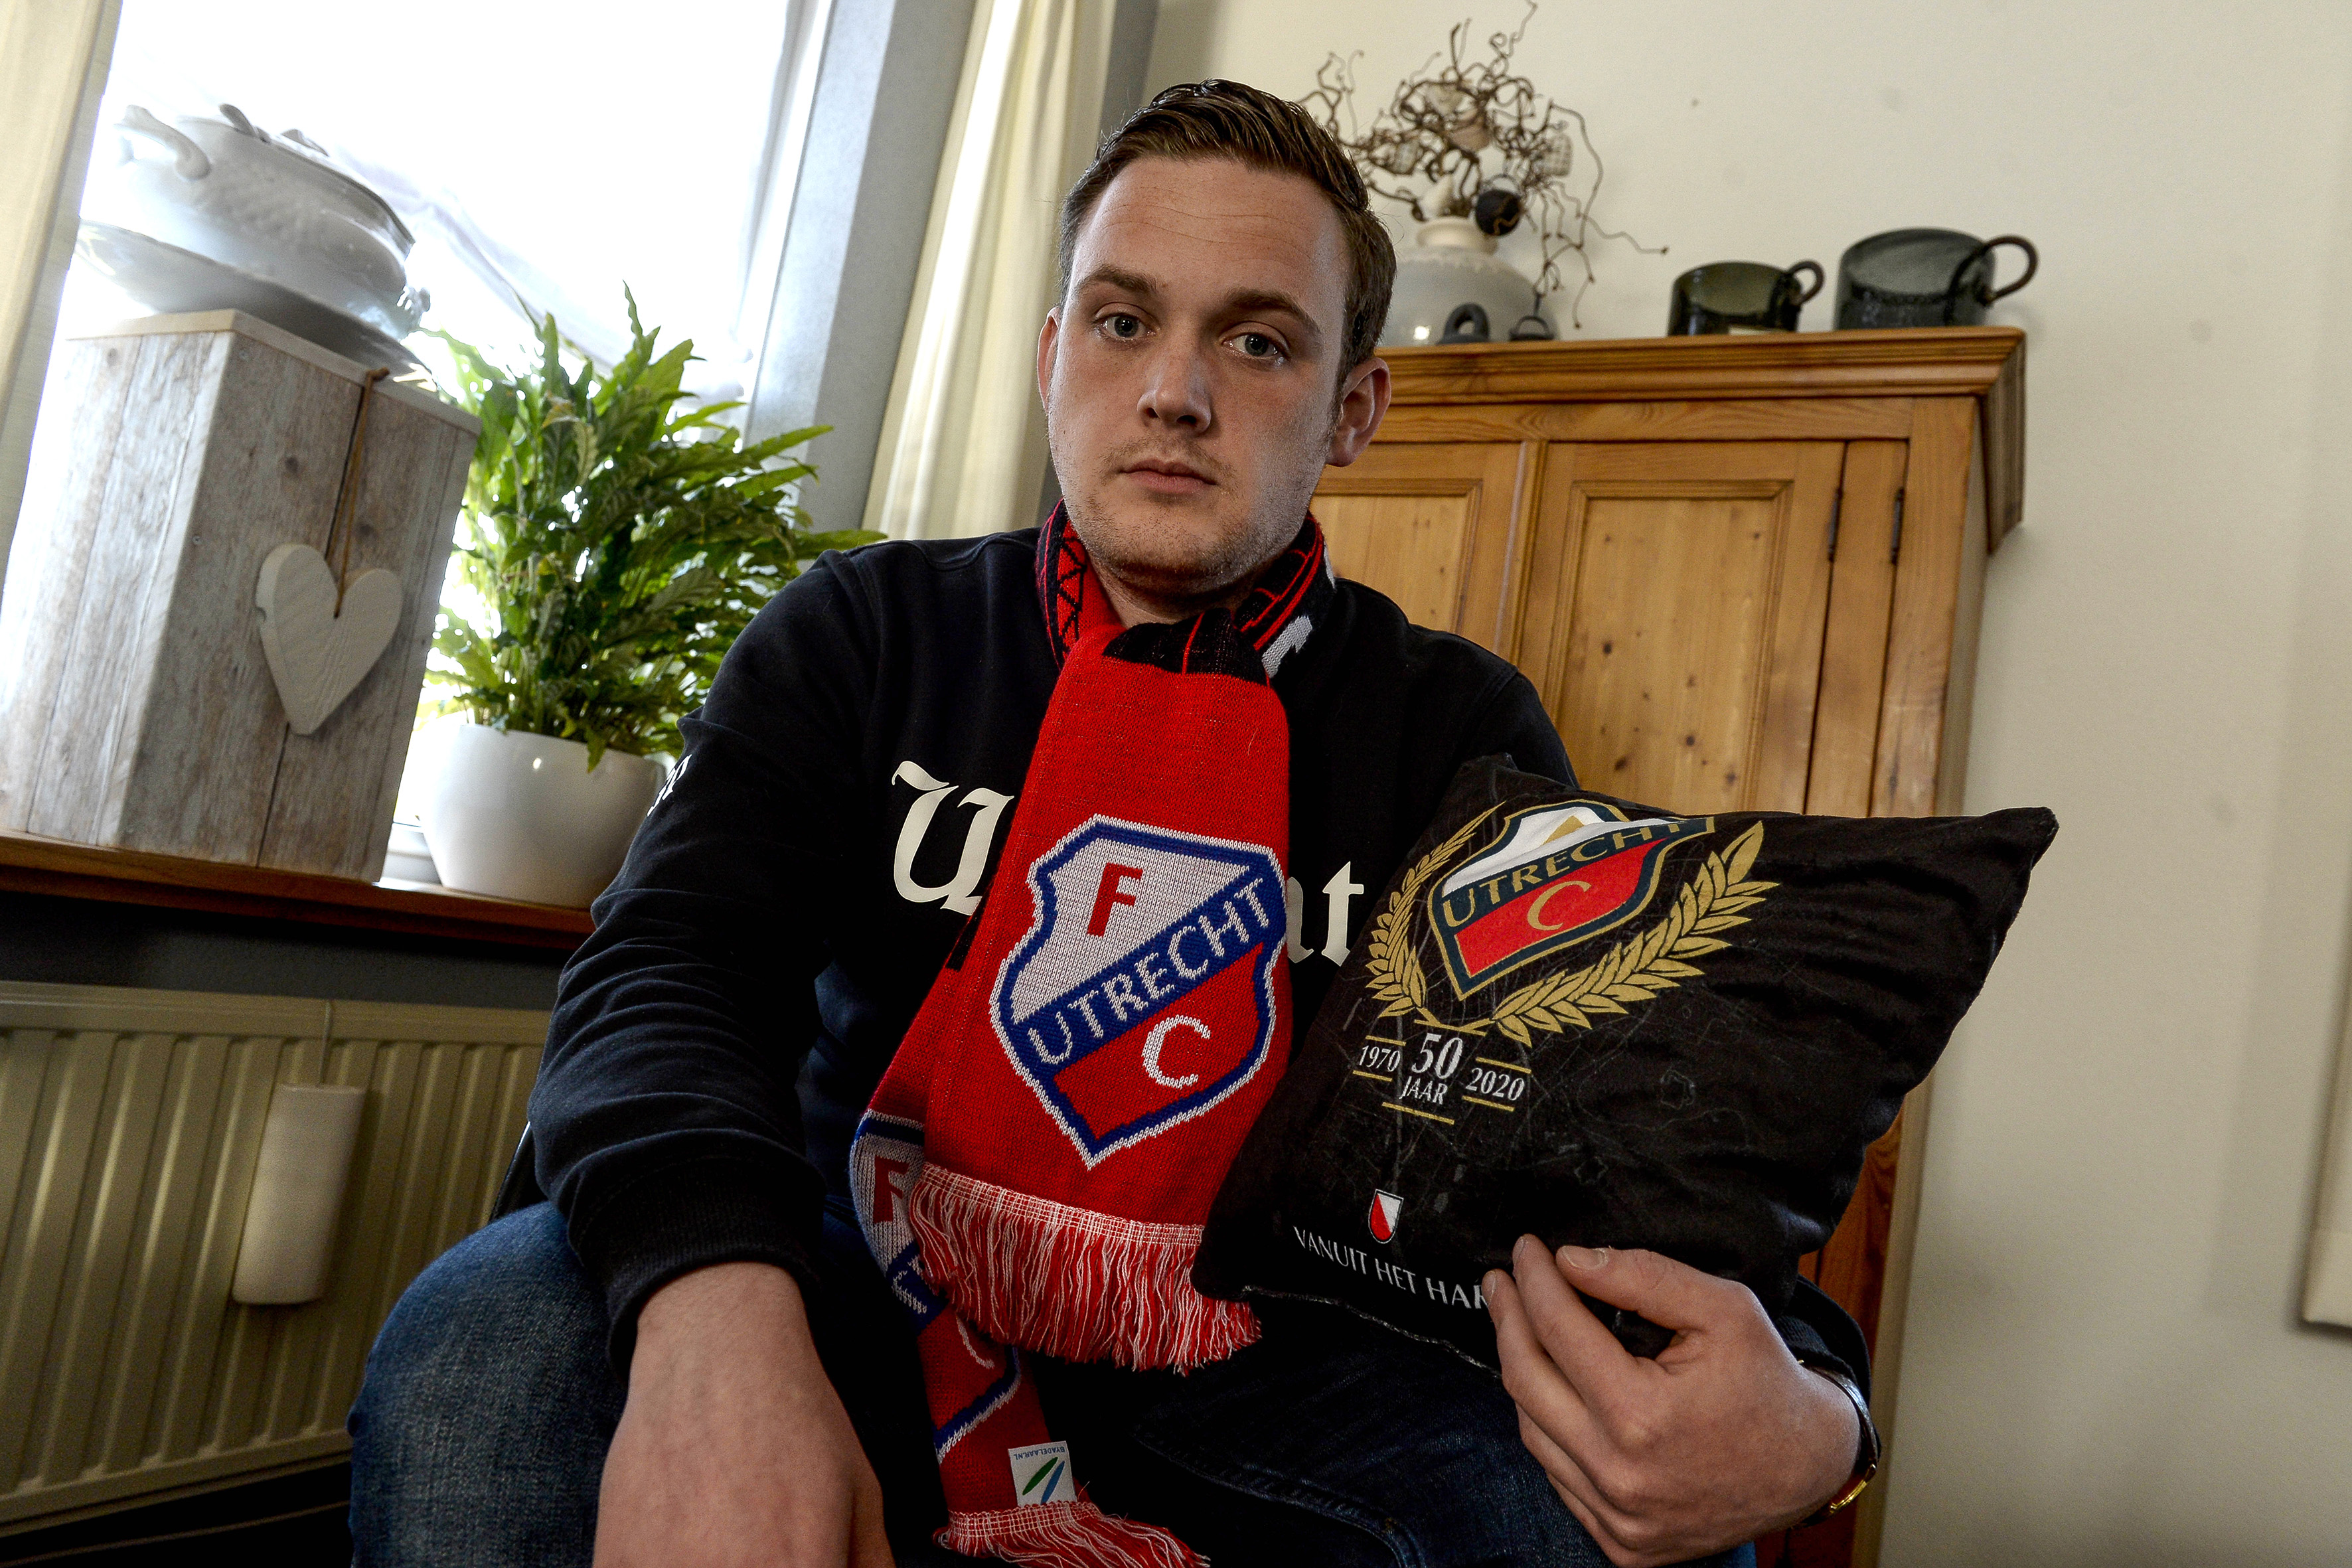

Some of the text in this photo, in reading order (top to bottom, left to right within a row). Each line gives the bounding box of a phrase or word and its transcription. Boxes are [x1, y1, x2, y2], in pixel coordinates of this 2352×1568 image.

[1086, 863, 1144, 937] F
[1526, 880, 1592, 931] C
[1027, 878, 1270, 1064] UTRECHT
[1142, 1014, 1212, 1089] C
[1359, 1032, 1526, 1101] 1970 50 2020
[1398, 1075, 1449, 1105] JAAR
[872, 1154, 910, 1223] F
[1293, 1225, 1488, 1310] VANUIT HET HAR
[1013, 1446, 1065, 1460] BYADELAAR.NL
